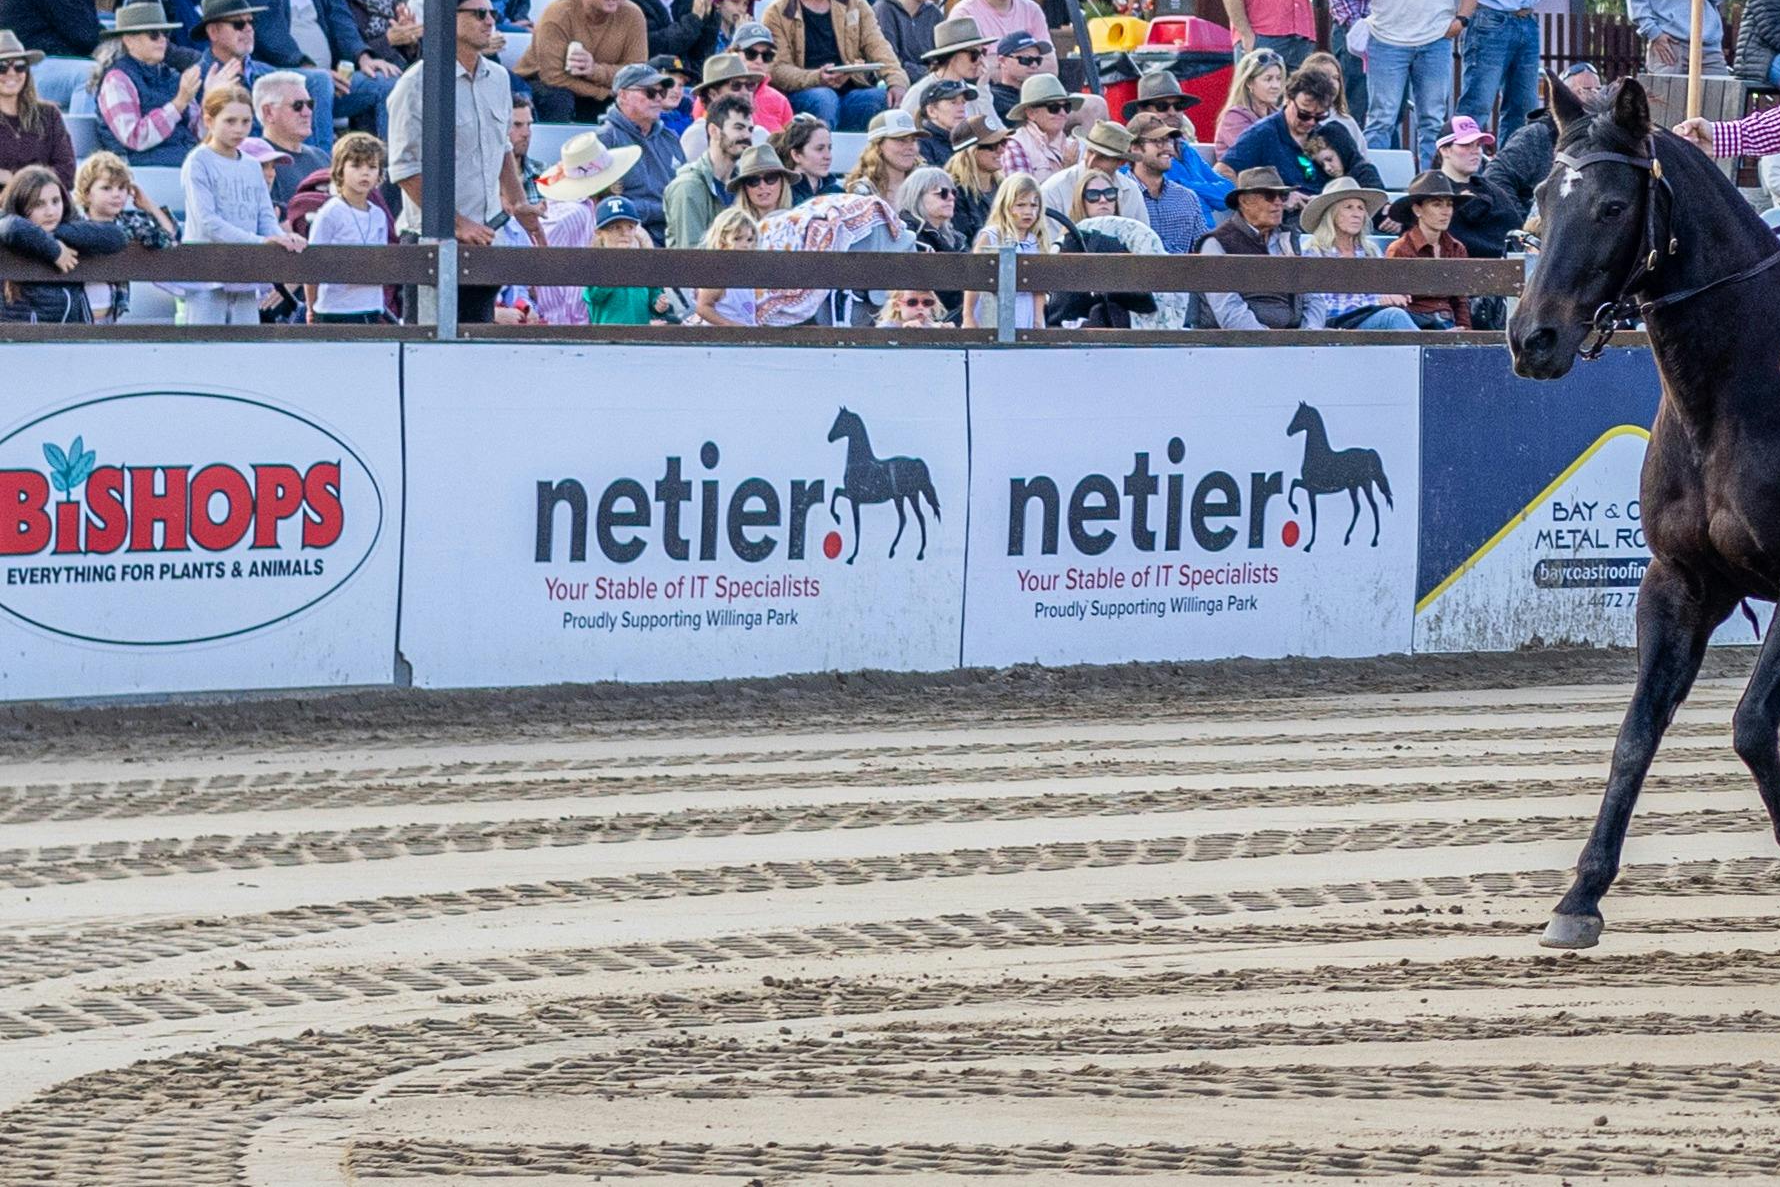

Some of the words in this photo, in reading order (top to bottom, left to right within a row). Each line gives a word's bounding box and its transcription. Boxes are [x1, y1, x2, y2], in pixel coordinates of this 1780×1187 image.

[1553, 501, 1598, 521] BAY
[1604, 503, 1620, 519] &
[1535, 529, 1609, 549] METAL
[7, 565, 116, 585] EVERYTHING
[121, 564, 154, 581] FOR
[160, 562, 225, 580] PLANTS
[231, 561, 243, 578] &
[248, 559, 324, 577] ANIMALS
[1017, 569, 1060, 591] Your
[1065, 566, 1125, 590] Stable
[1131, 565, 1151, 588] of
[1156, 565, 1173, 587] IT
[1179, 562, 1279, 591] Specialists
[1540, 561, 1647, 584] baycoastroofin
[545, 576, 589, 601] Your
[595, 576, 658, 600] Stable
[664, 575, 686, 599] of
[690, 575, 709, 599] IT
[715, 574, 820, 604] Specialists
[1588, 593, 1623, 608] 4472
[1035, 600, 1087, 621] Proudly
[1090, 598, 1166, 619] Supporting
[1170, 596, 1223, 616] Willinga
[1228, 594, 1258, 611] Park
[563, 611, 617, 633] Proudly
[621, 610, 701, 632] Supporting
[706, 609, 763, 630] Willinga
[767, 608, 799, 626] Park
